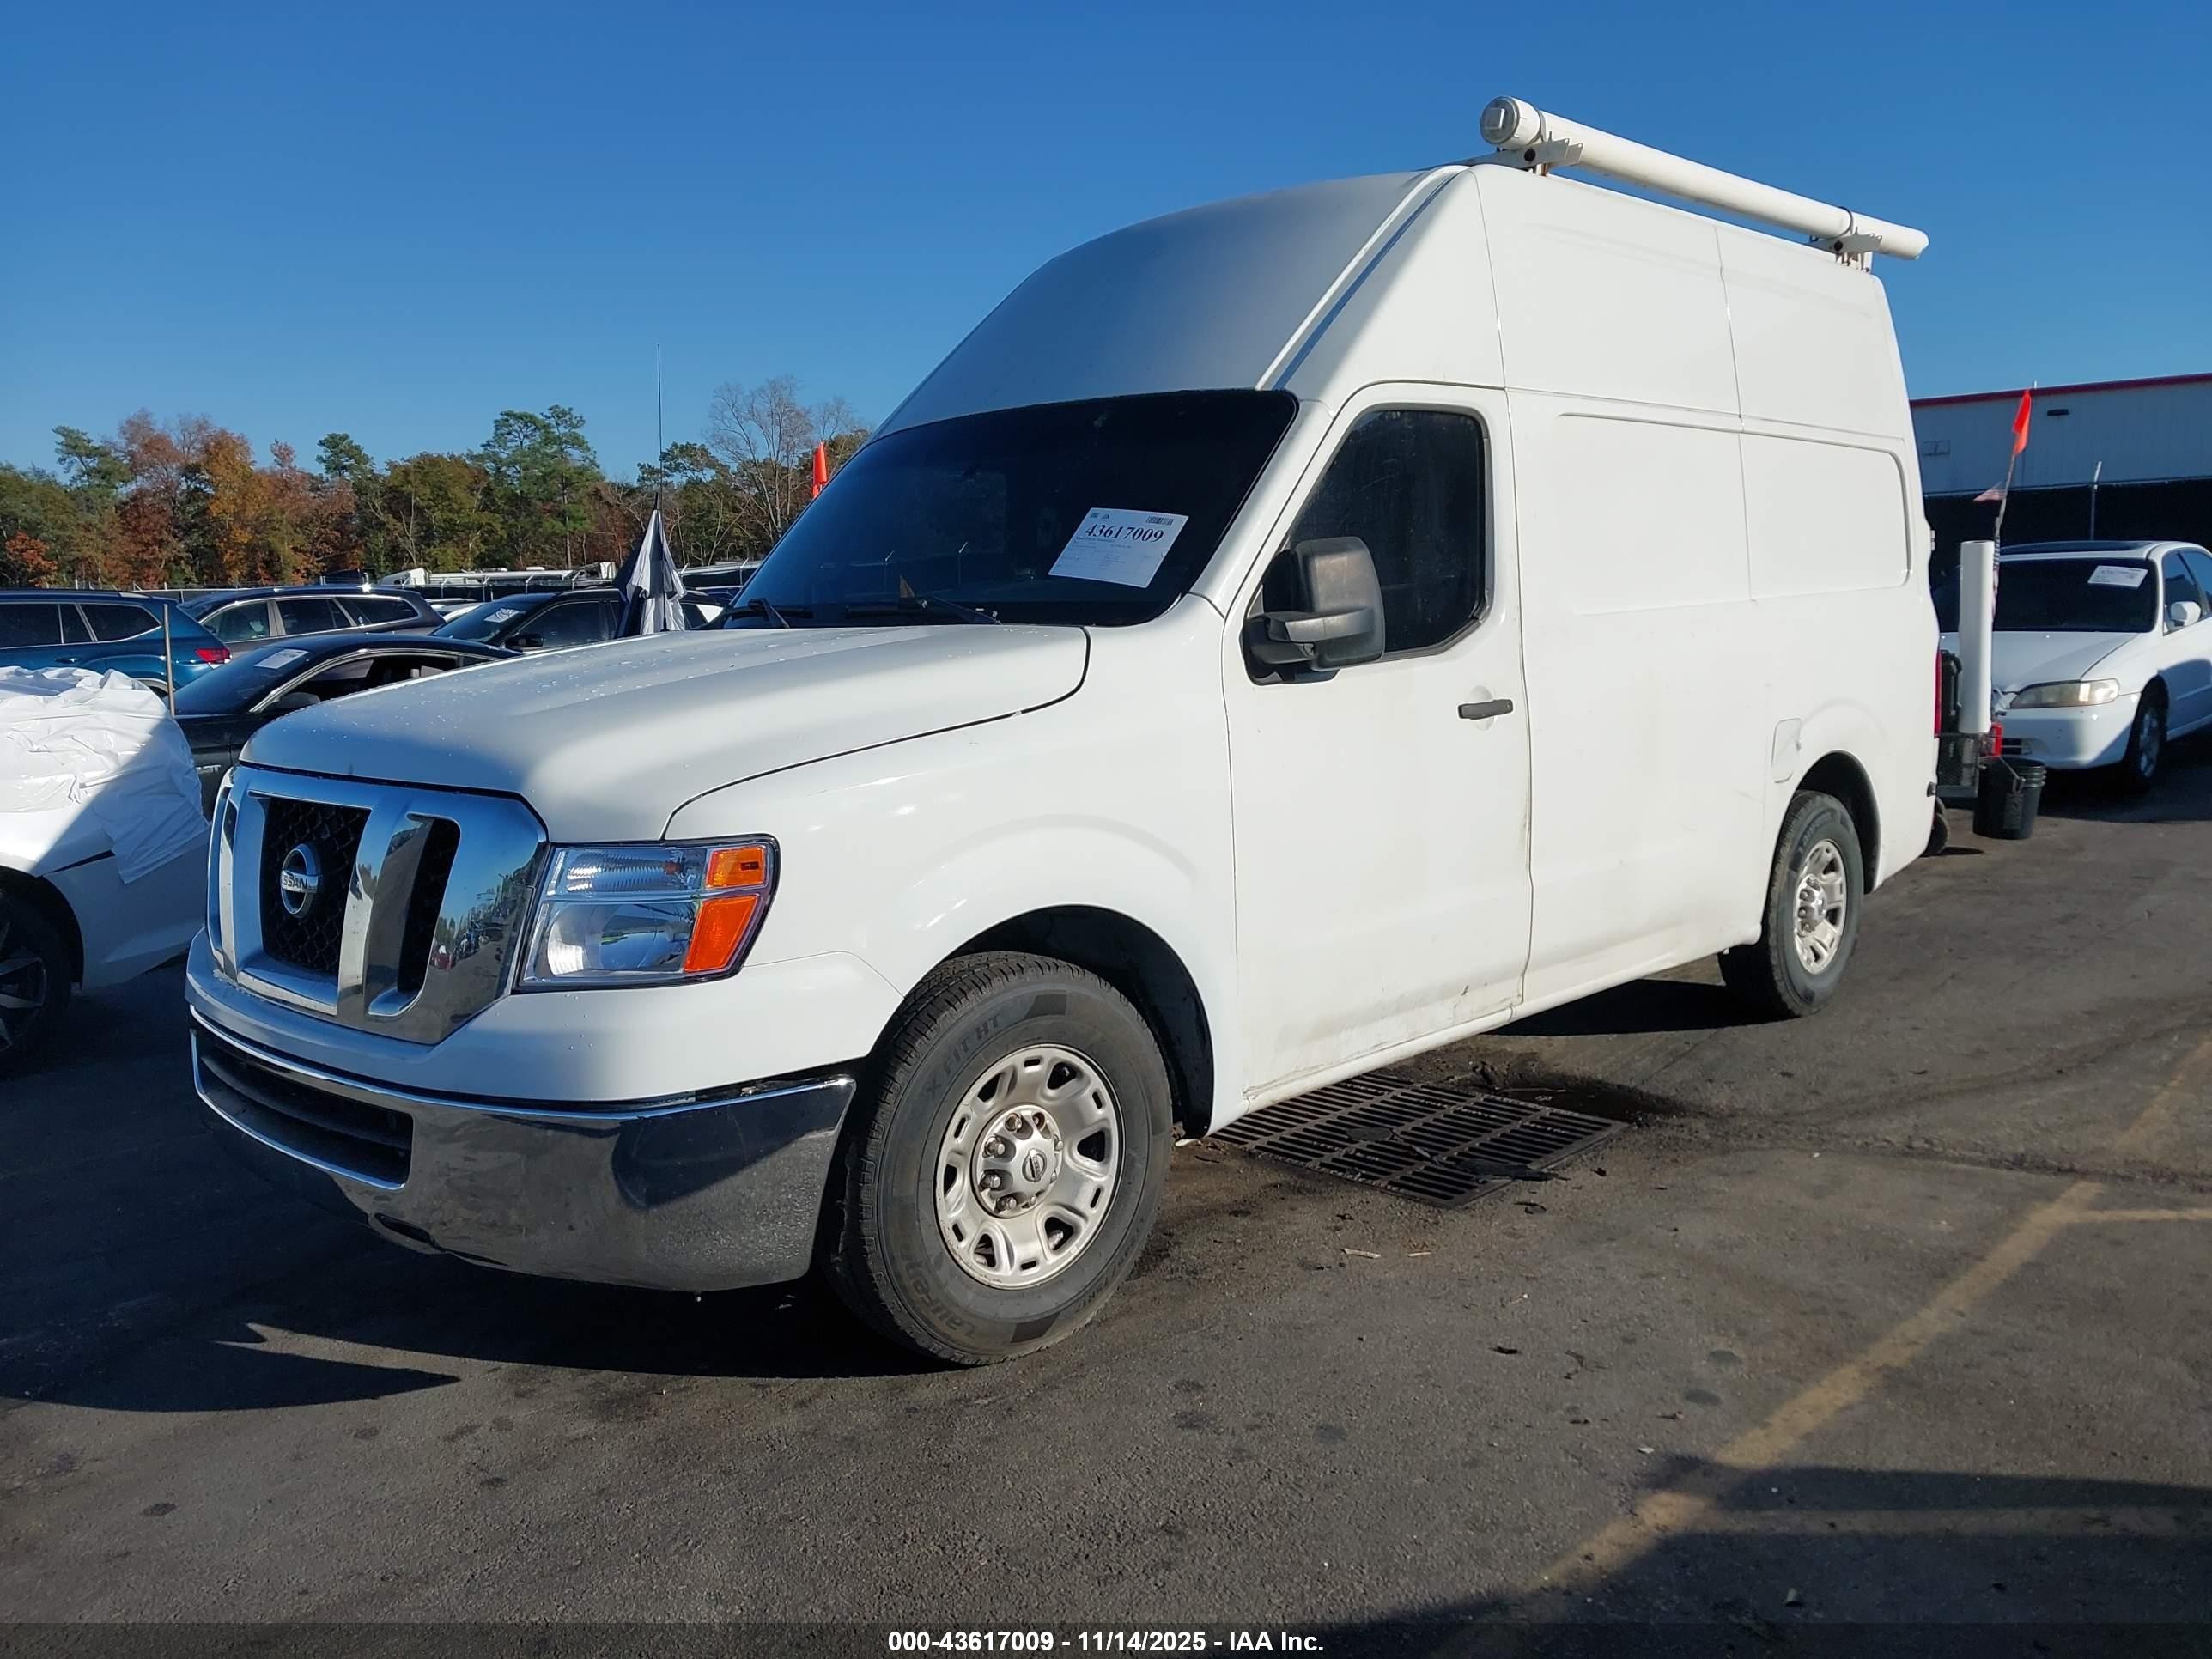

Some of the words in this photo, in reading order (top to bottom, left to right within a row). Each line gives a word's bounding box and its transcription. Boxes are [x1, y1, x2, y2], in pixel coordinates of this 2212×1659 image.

[1085, 524, 1164, 543] 43617009
[281, 874, 308, 890] SSAN
[974, 1015, 1000, 1041] HT
